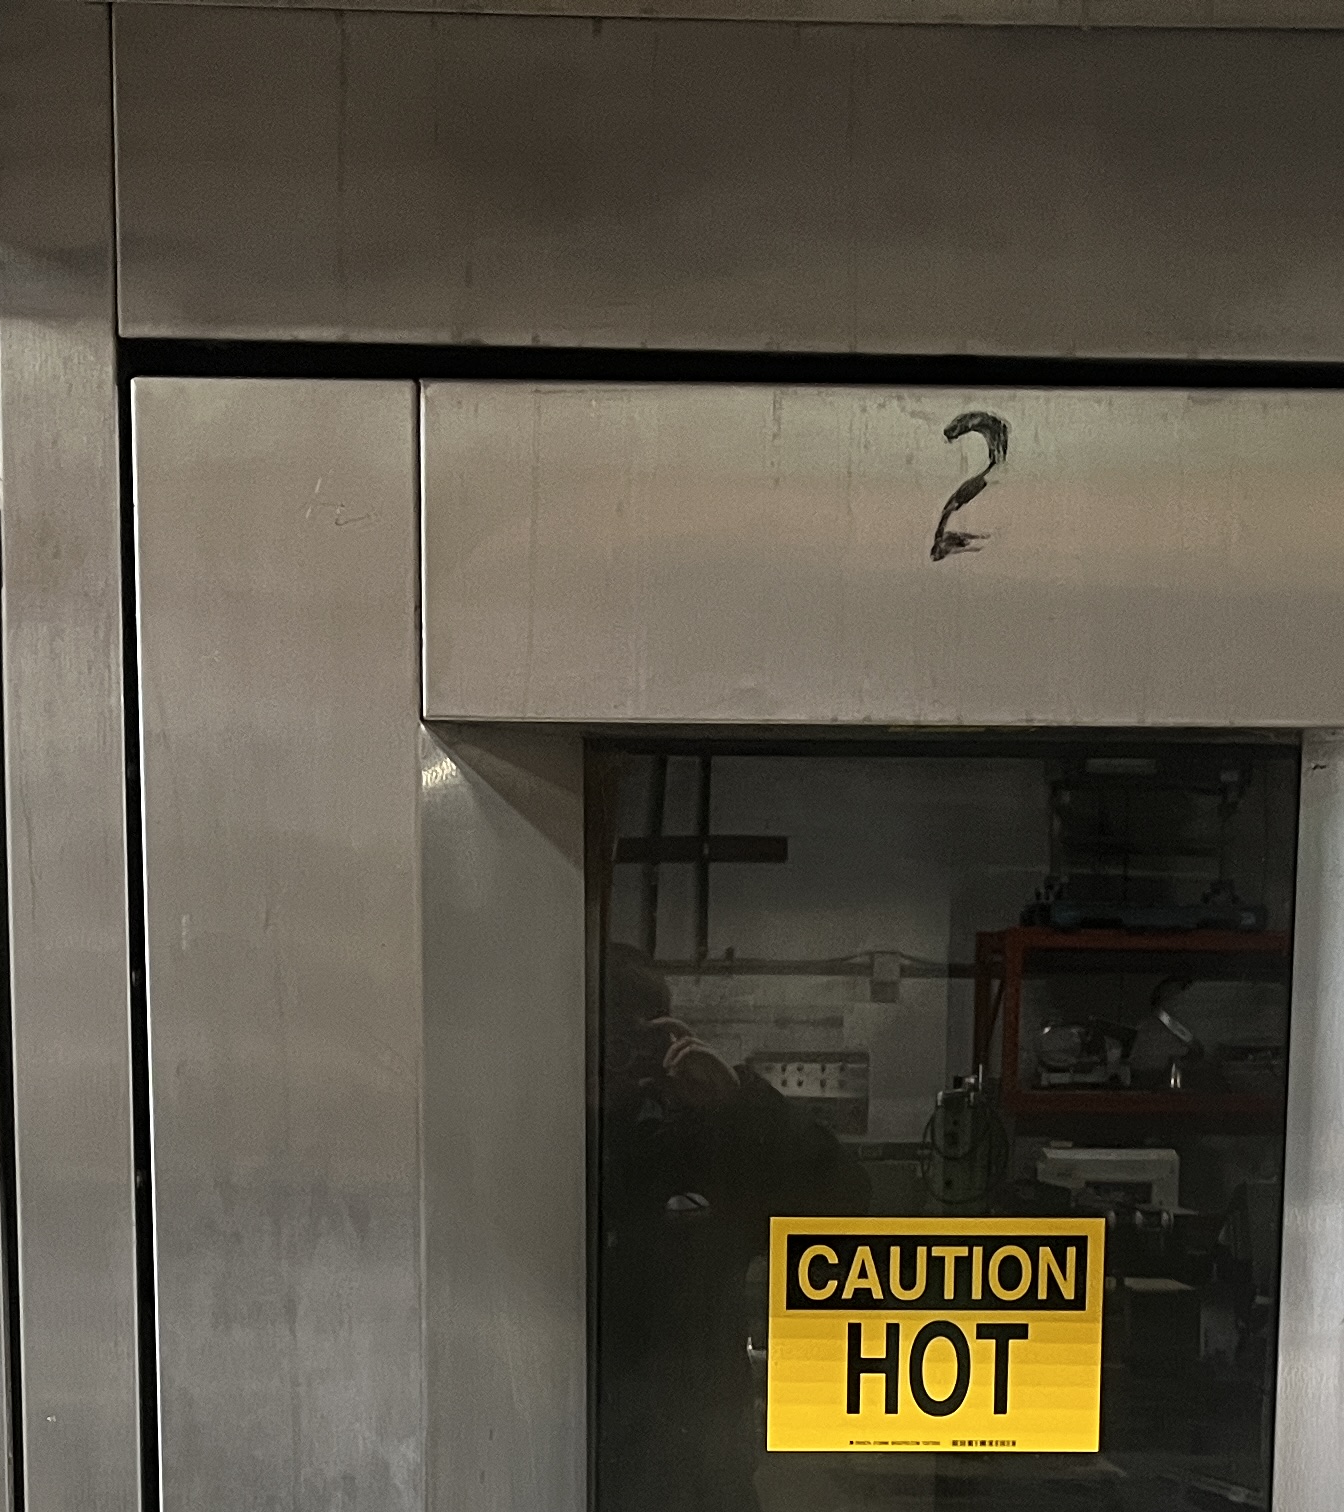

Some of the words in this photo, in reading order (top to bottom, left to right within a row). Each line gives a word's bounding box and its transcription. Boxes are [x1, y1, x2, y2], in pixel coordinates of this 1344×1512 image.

[930, 411, 1008, 562] 2
[798, 1244, 1077, 1301] CAUTION
[846, 1319, 1029, 1418] HOT
